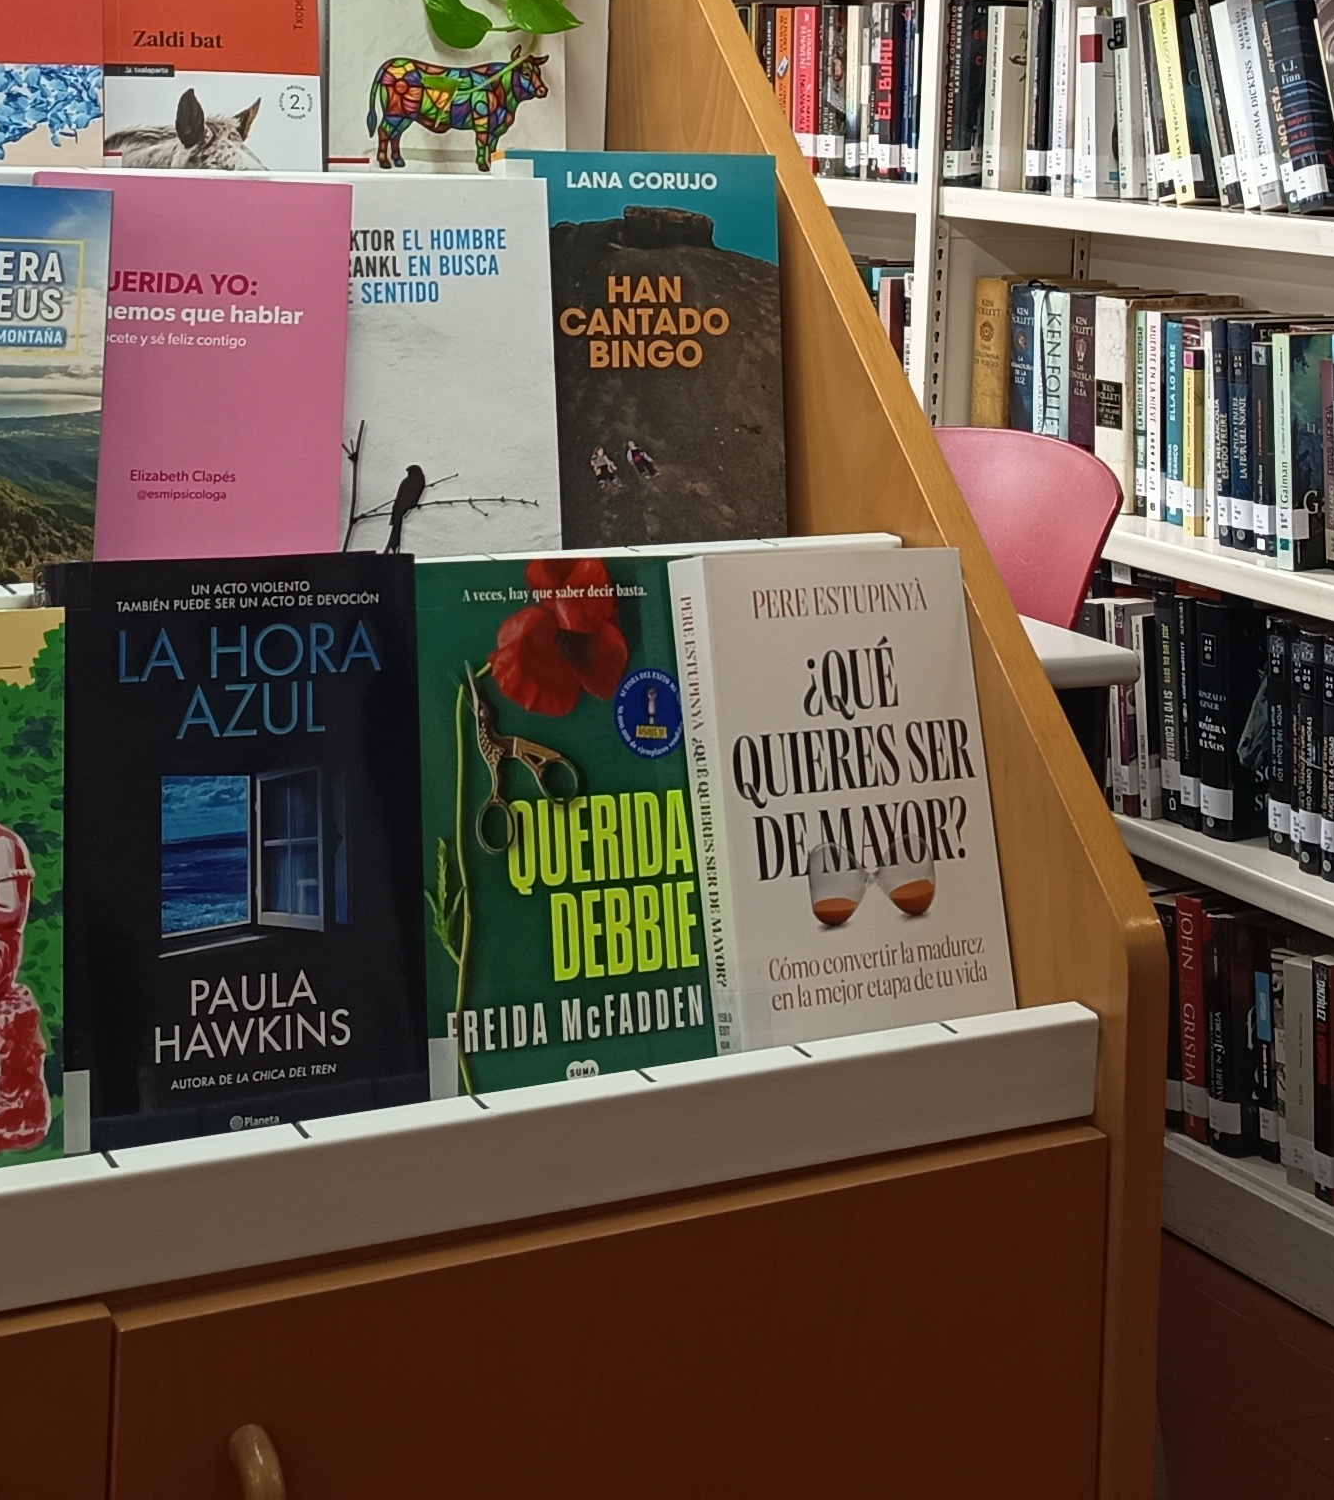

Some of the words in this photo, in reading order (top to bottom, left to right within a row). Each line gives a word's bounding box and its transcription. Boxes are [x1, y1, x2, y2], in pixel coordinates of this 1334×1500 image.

[133, 30, 185, 49] Zaldi
[190, 32, 223, 50] bat
[290, 94, 304, 110] 2.
[877, 94, 892, 120] EL
[566, 171, 623, 189] LANA
[628, 172, 717, 190] CORUJO
[350, 230, 395, 251] KTOR
[402, 230, 423, 251] EL
[430, 229, 507, 251] HOMBRE
[108, 271, 203, 295] UERIDA
[210, 274, 257, 296] YO:
[408, 256, 431, 277] EN
[439, 255, 499, 277] BUSCA
[361, 281, 439, 305] SENTIDO
[608, 276, 681, 303] HAN
[181, 308, 225, 327] que
[230, 306, 303, 326] hablar
[559, 307, 730, 336] CANTADO
[589, 339, 704, 368] BINGO
[129, 469, 190, 483] Elizabeth
[192, 470, 237, 487] Clapés
[752, 587, 808, 620] PERE
[813, 577, 928, 617] ESTUPINYÀ
[118, 627, 185, 683] LA
[210, 619, 382, 678] HORA
[802, 636, 899, 720] ¿QUÉ
[176, 680, 326, 740] AZUL
[732, 723, 902, 809] QUIERES
[904, 719, 975, 784] SER
[508, 789, 694, 895] QUERIDA
[753, 811, 809, 881] DE
[819, 795, 967, 877] MAYOR?
[550, 881, 700, 981] DEBBIE
[1177, 909, 1194, 971] JOHN
[769, 956, 820, 983] Cómo
[823, 940, 897, 975] convertir
[899, 940, 915, 964] la
[917, 934, 984, 963] madurez
[190, 969, 318, 1017] PAULA
[561, 985, 704, 1043] McFADDEN
[154, 1008, 351, 1064] HAWKINS
[1182, 1003, 1197, 1081] GRISHA
[569, 1066, 595, 1077] SUMA
